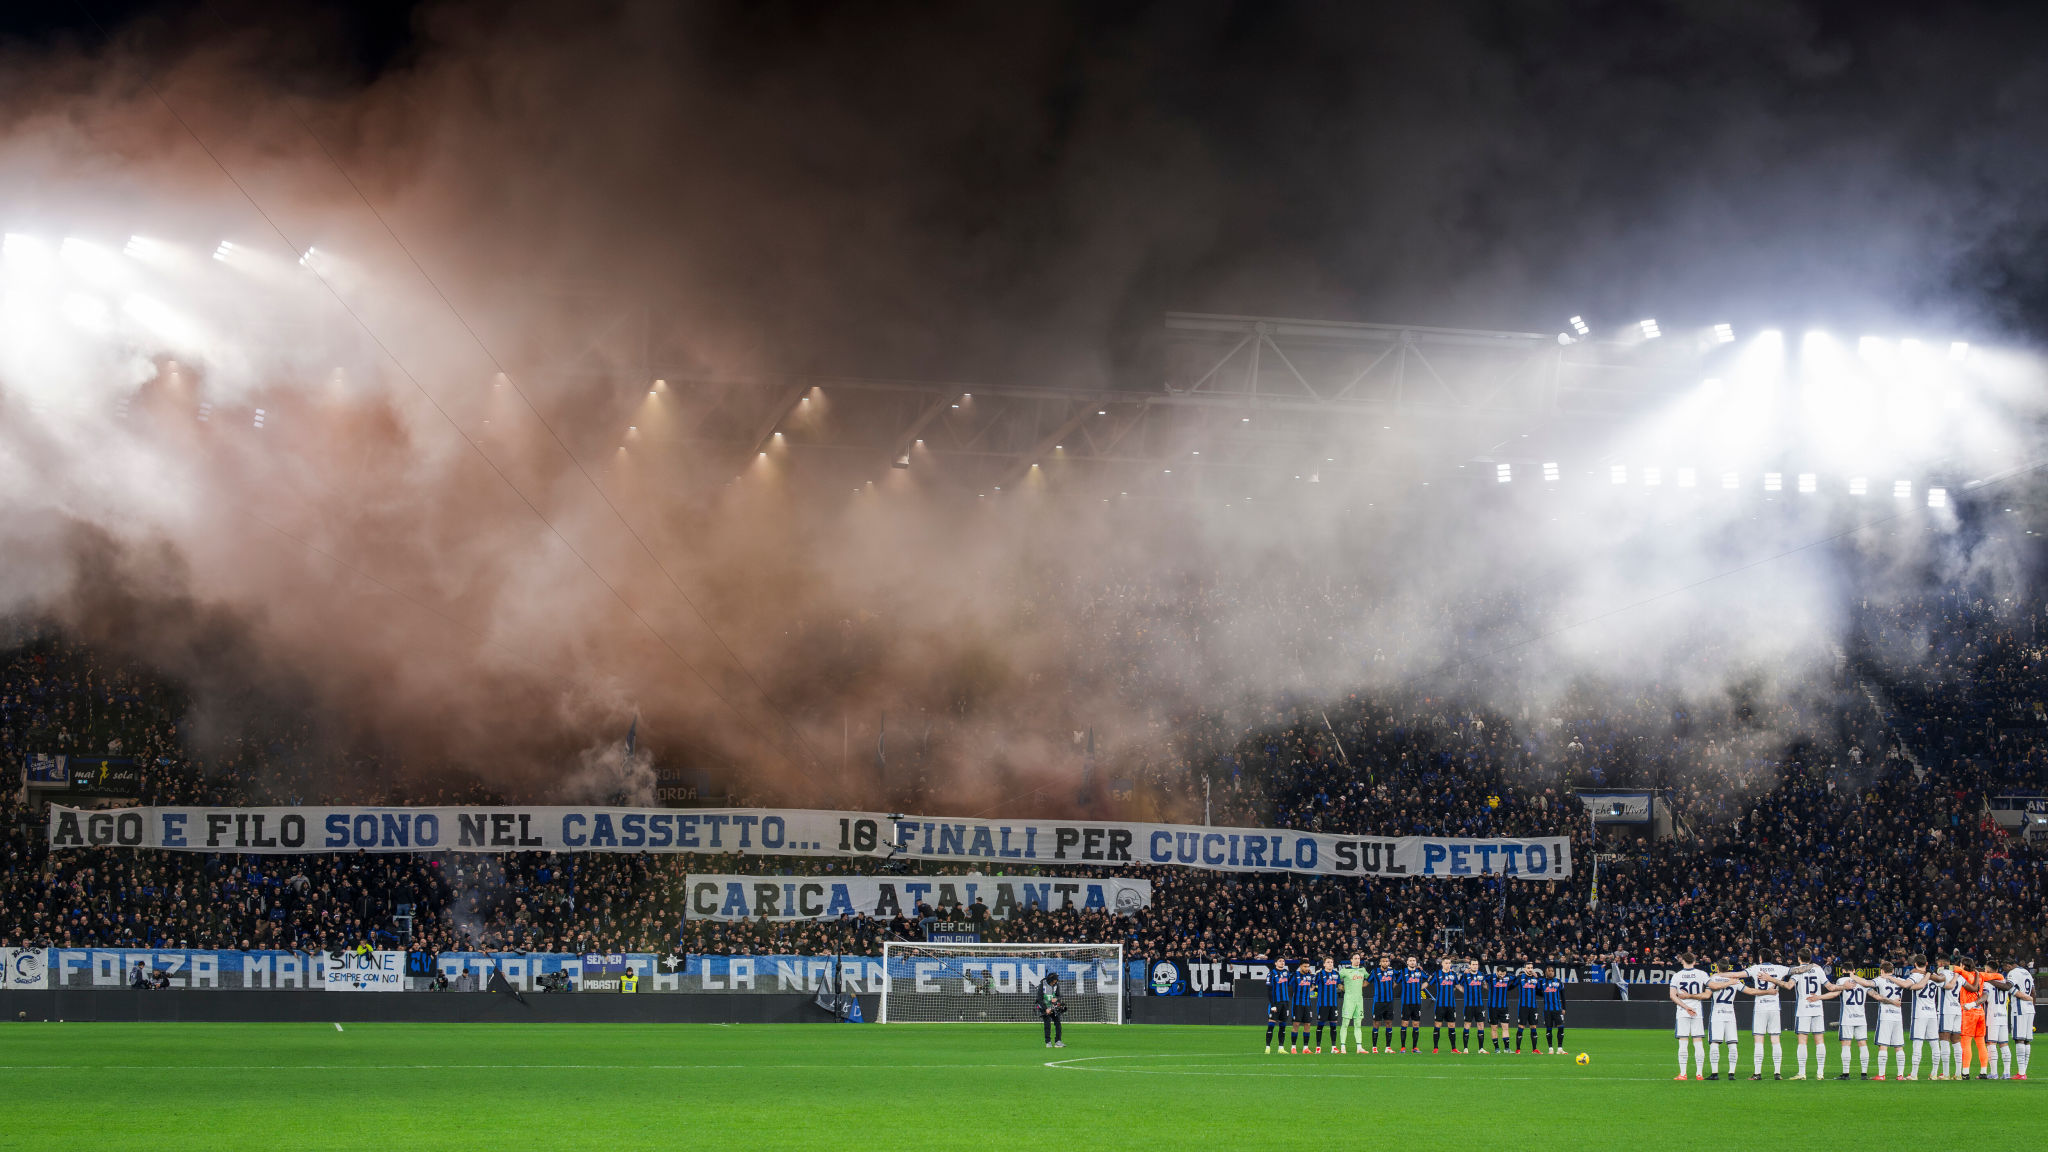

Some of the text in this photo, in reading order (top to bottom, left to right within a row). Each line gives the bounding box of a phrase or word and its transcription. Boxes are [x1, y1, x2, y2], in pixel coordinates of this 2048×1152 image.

[75, 769, 133, 779] mai sola
[53, 812, 143, 845] AGO
[162, 813, 187, 846] E
[206, 814, 306, 847] FILO
[325, 814, 439, 847] SONO
[458, 813, 542, 846] NEL
[562, 814, 820, 849] CASSETTO...
[896, 821, 1037, 858] FINALI
[1054, 827, 1132, 861] PER
[1150, 831, 1318, 868] CUCIRLO
[1335, 841, 1406, 872] SUL
[1424, 843, 1561, 874] PETTO!
[693, 882, 855, 917] CARICA
[933, 922, 975, 932] PER CHI
[330, 952, 396, 971] SIMONE
[59, 951, 219, 988] FORZA
[702, 959, 755, 990] LA
[778, 961, 893, 993] NORD
[1068, 963, 1119, 994] TE
[328, 973, 399, 983] SEMPRE CON NOI
[1679, 981, 1700, 995] 30
[1804, 976, 1818, 994] 15
[1885, 986, 1902, 998] 23
[1919, 982, 1937, 998] 28
[2025, 979, 2031, 995] 9
[1716, 986, 1734, 1004] 22
[1846, 988, 1864, 1005] 20
[1992, 987, 2005, 1005] 10
